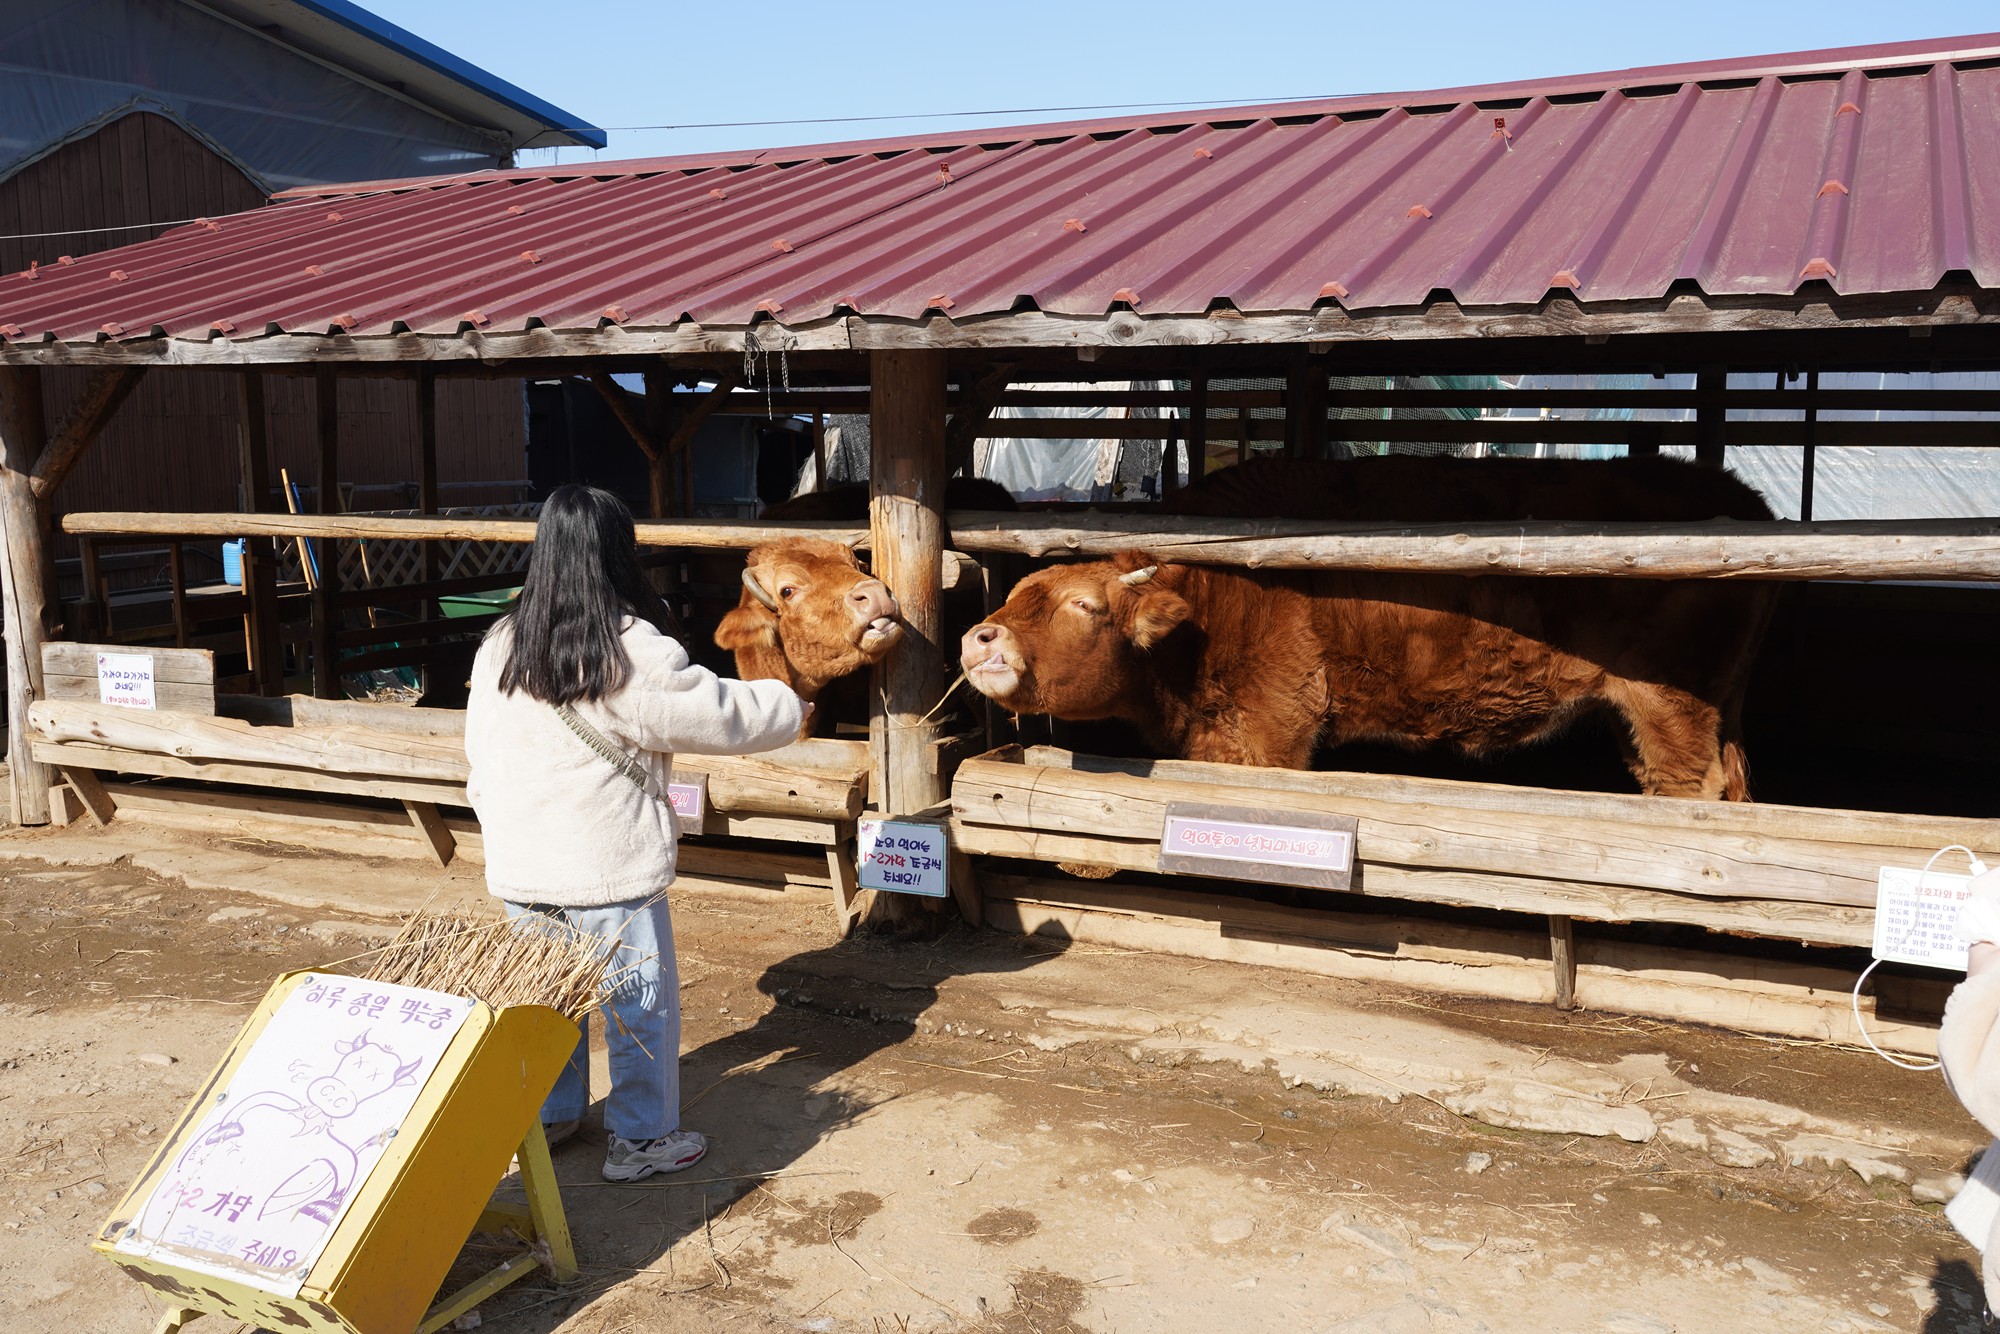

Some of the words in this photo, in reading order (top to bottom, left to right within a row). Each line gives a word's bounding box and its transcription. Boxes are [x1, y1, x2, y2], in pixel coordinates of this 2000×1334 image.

[898, 837, 931, 853] 먹이는
[1180, 828, 1240, 848] 먹이통에
[909, 855, 942, 871] 조금씩
[883, 870, 922, 885] 주세요!!
[305, 984, 347, 1009] 하루
[347, 992, 390, 1019] 종일
[399, 998, 453, 1030] 먹는중
[240, 1239, 298, 1268] 주세요
